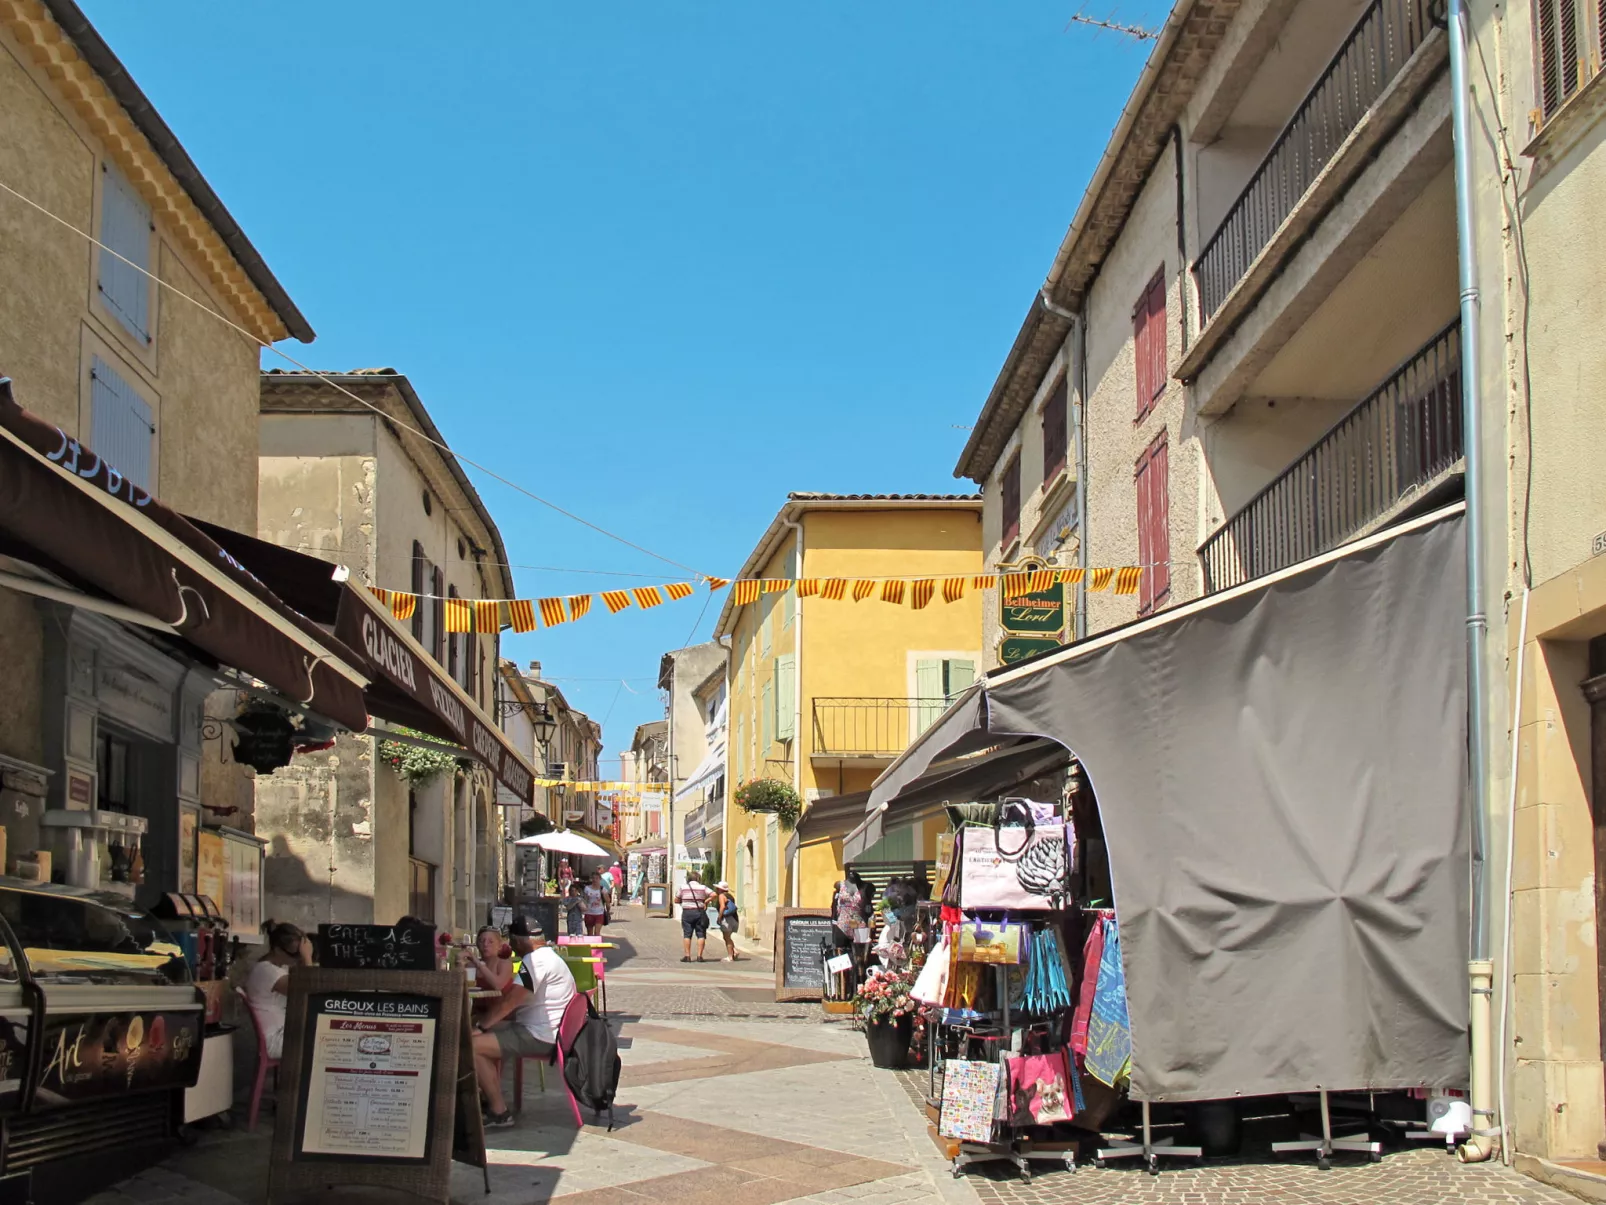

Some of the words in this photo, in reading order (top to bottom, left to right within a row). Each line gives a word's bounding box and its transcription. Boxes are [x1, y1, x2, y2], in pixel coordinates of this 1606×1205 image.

[1004, 597, 1061, 608] Bellheimer
[1010, 606, 1055, 622] Lord
[362, 613, 417, 692] GLACIER
[428, 674, 468, 740] PIZZERIA
[324, 998, 375, 1012] GRÉOUX
[377, 1002, 395, 1013] LES
[397, 1003, 429, 1014] BAINS
[340, 1021, 353, 1030] Les
[353, 1021, 377, 1031] Menus
